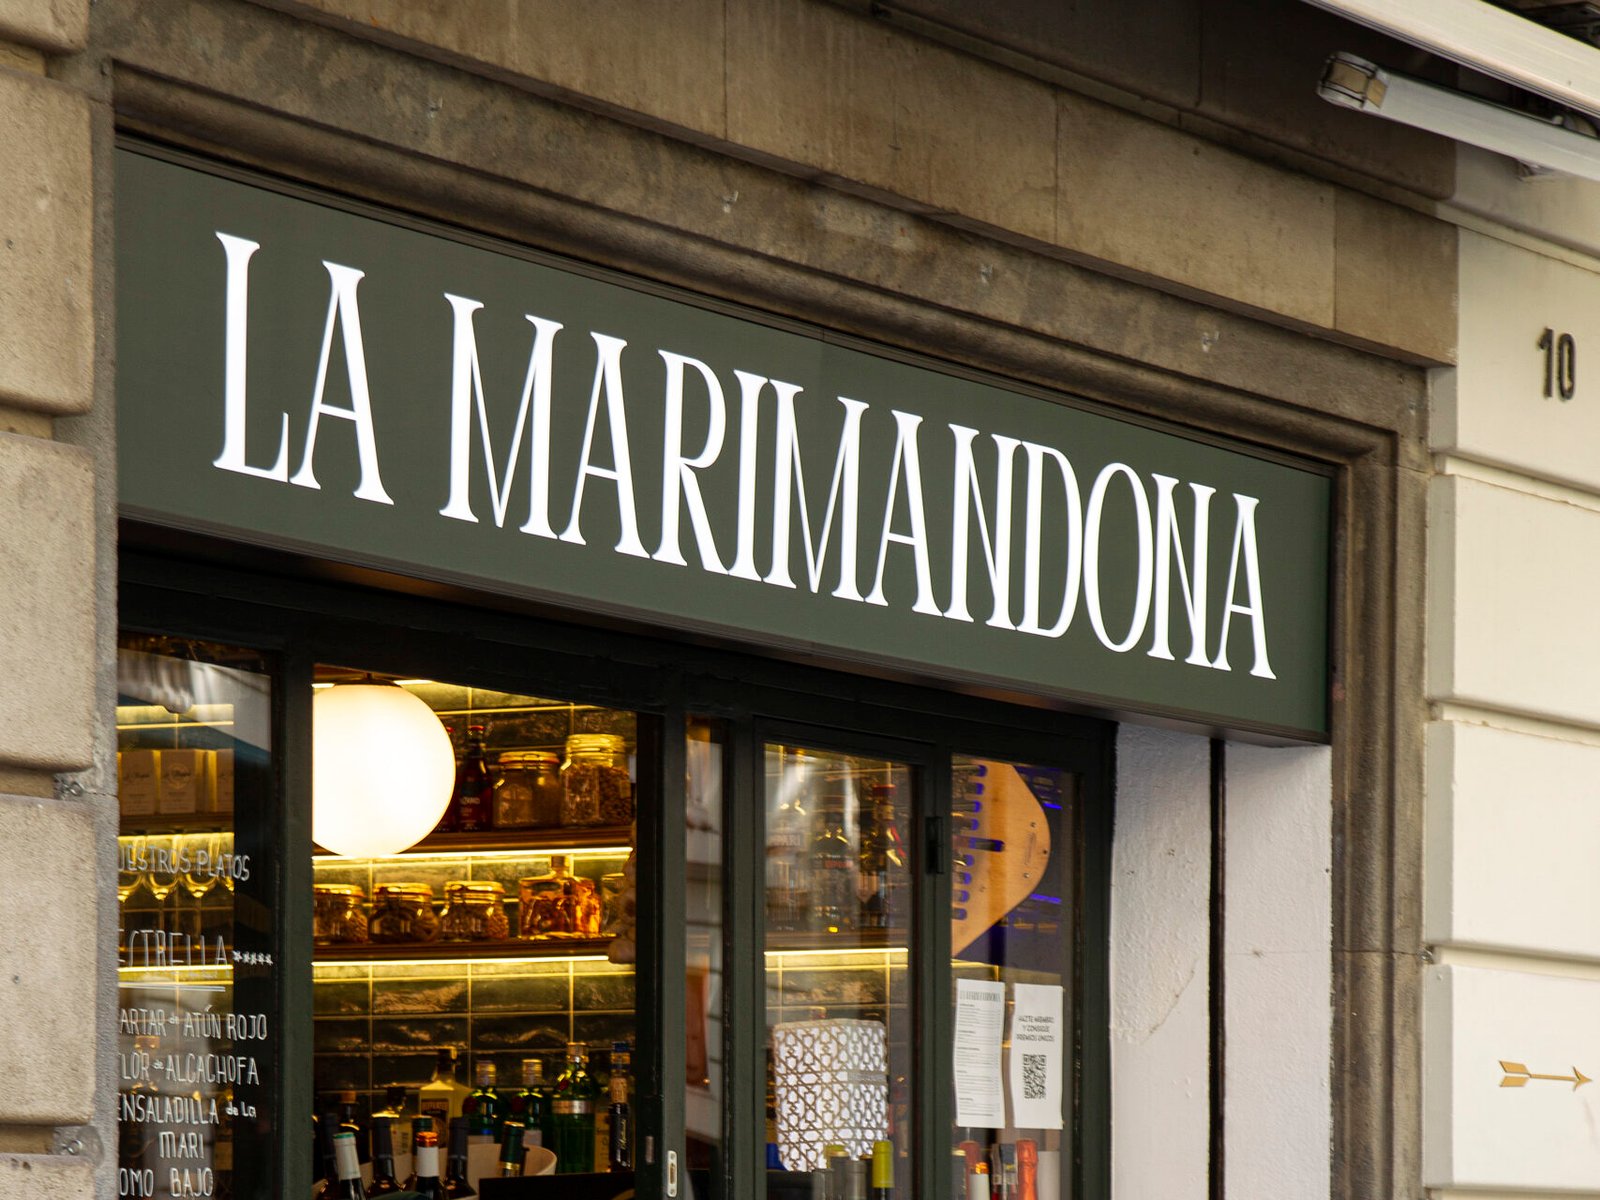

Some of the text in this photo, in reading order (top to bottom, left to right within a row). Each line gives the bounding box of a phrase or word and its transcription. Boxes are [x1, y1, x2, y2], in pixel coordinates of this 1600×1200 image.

[1536, 326, 1576, 402] 10
[212, 230, 1277, 680] LA MARIMANDONA
[196, 850, 250, 882] PLATOS
[183, 1004, 222, 1039] ATÚN
[226, 1013, 268, 1041] ROJO
[119, 1051, 150, 1081] LOR
[165, 1053, 260, 1086] ALCACHOFA
[169, 1167, 214, 1198] BAJO
